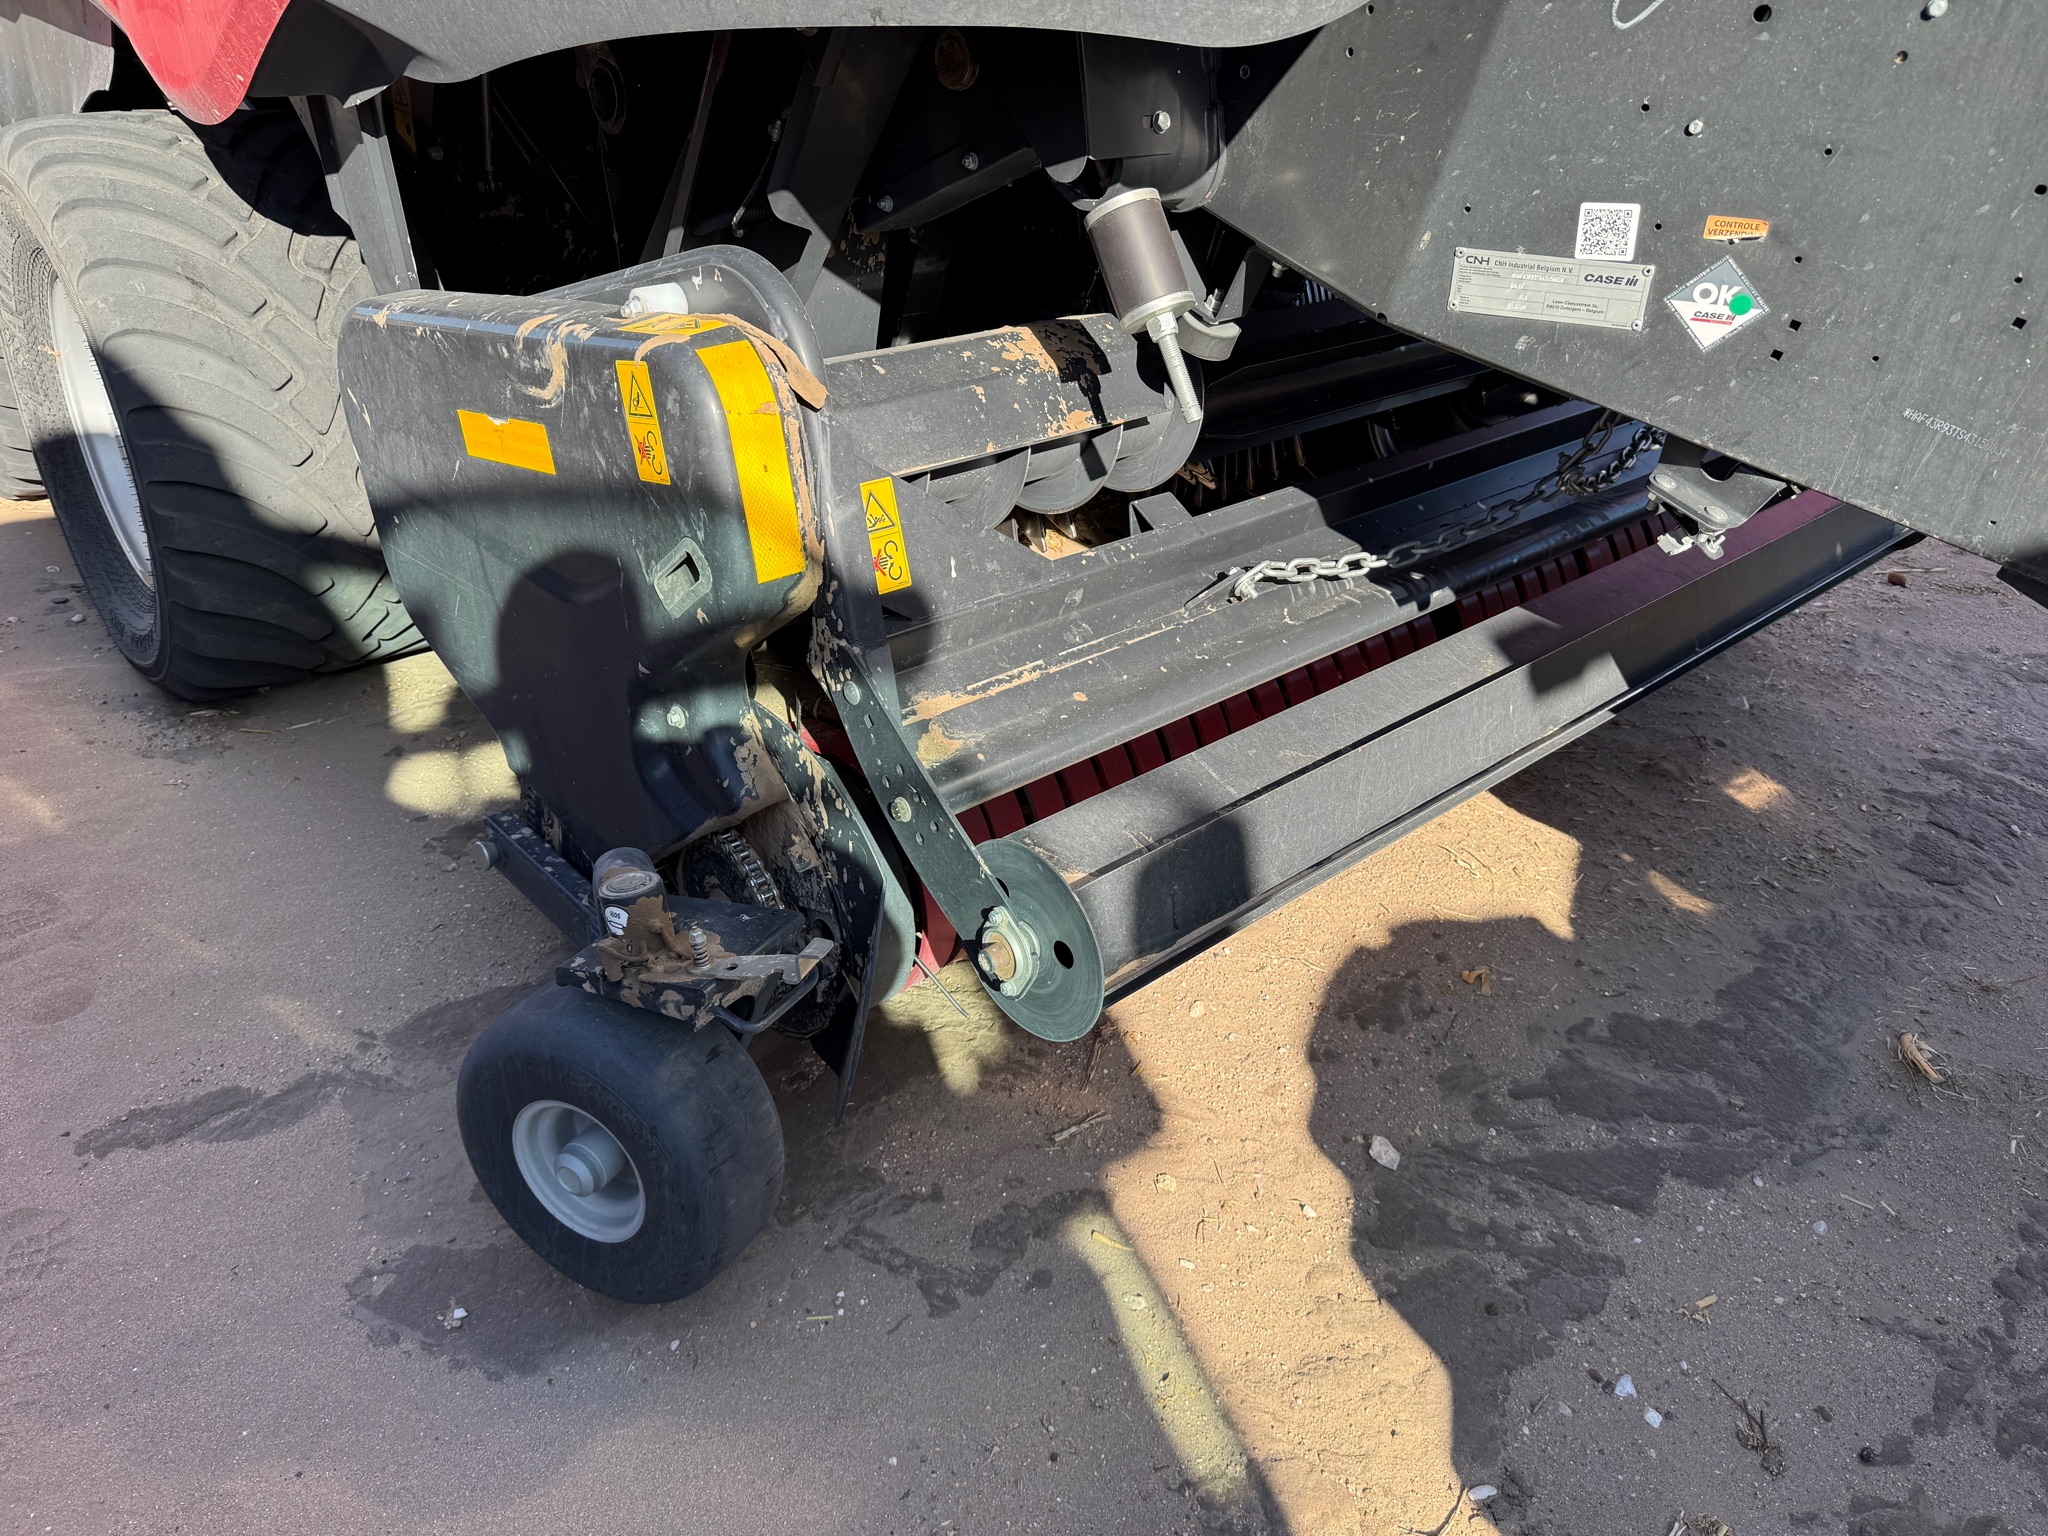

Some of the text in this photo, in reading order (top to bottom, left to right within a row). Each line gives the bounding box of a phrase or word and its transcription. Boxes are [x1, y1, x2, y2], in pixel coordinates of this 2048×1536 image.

[1714, 219, 1760, 231] CONTROLE
[1465, 255, 1491, 266] CNH
[1494, 259, 1507, 267] CNH
[1508, 260, 1536, 270] Industrial
[1536, 264, 1561, 273] Belgium
[1584, 273, 1625, 286] CASE
[1692, 282, 1743, 306] OK
[1693, 310, 1726, 320] CASE
